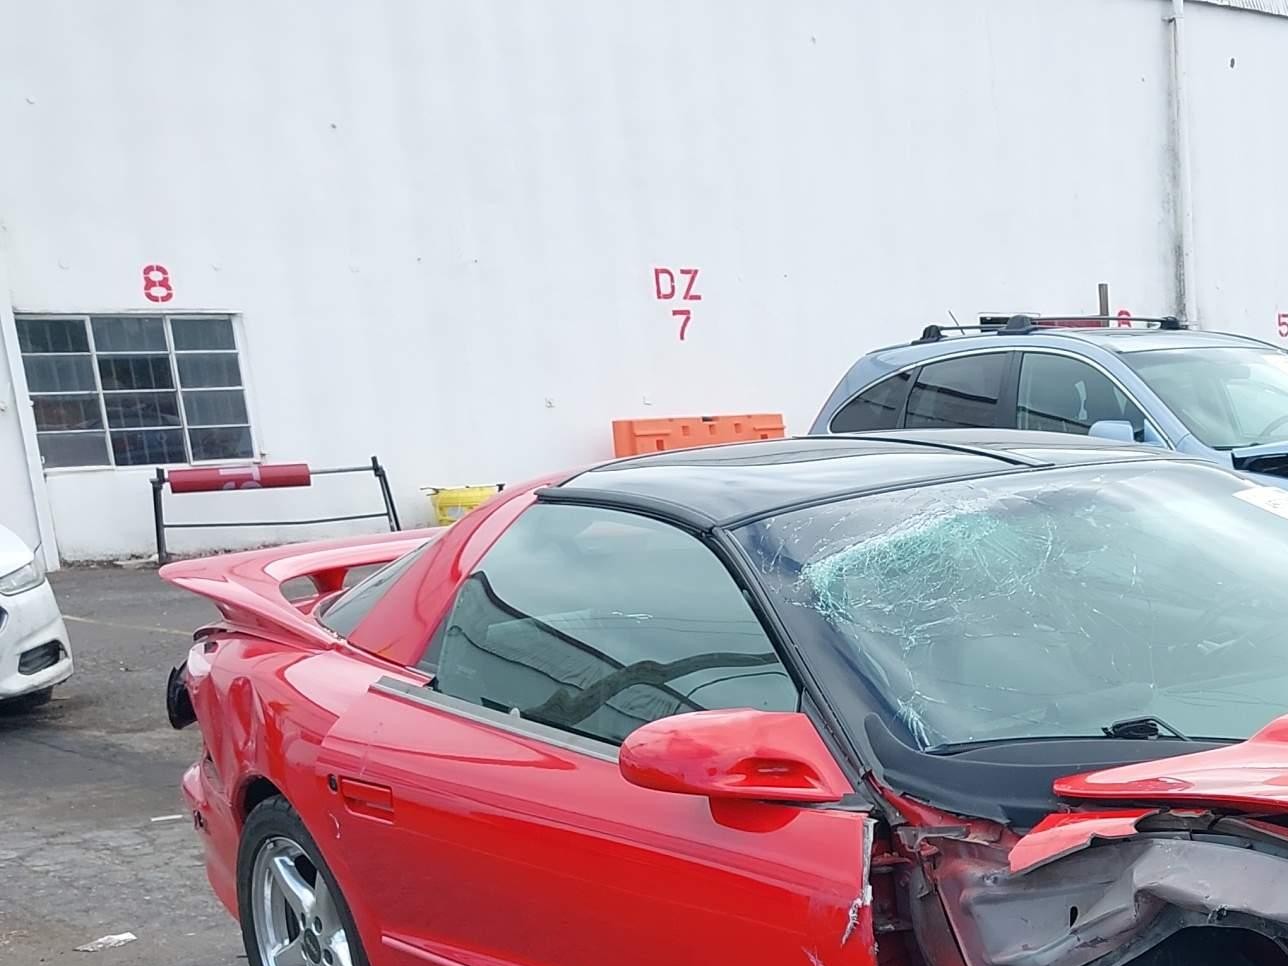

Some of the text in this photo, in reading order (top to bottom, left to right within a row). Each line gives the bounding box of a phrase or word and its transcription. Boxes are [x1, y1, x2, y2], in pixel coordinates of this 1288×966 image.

[143, 264, 174, 303] 8
[654, 268, 702, 300] DZ
[672, 309, 691, 341] 7
